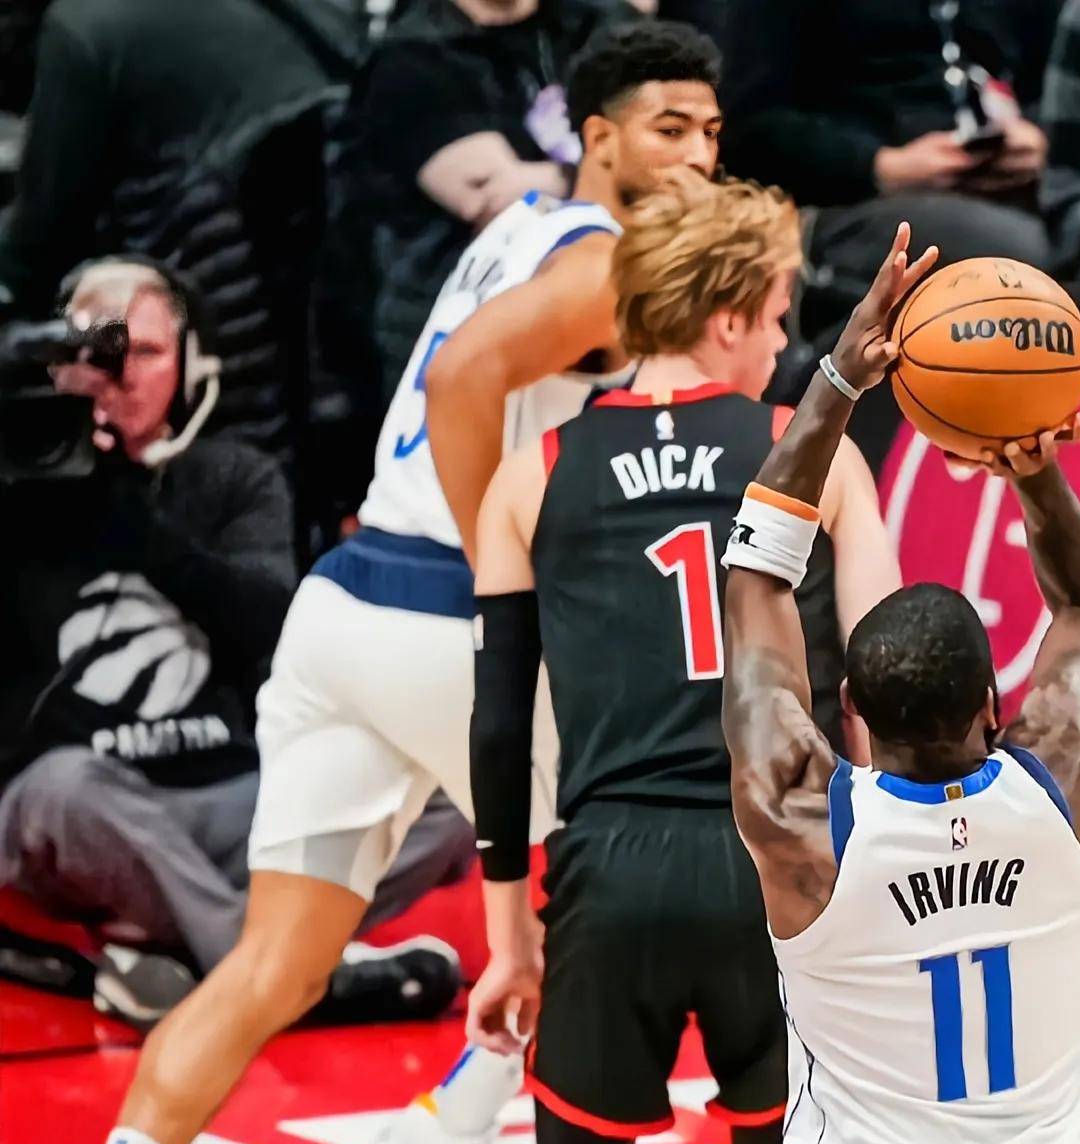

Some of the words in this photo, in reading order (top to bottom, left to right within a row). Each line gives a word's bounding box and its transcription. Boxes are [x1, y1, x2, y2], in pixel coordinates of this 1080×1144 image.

[950, 317, 1076, 356] Wilson
[609, 444, 725, 500] DICK
[643, 521, 725, 681] 1
[887, 858, 1025, 926] IRVING
[917, 942, 1017, 1103] 11
